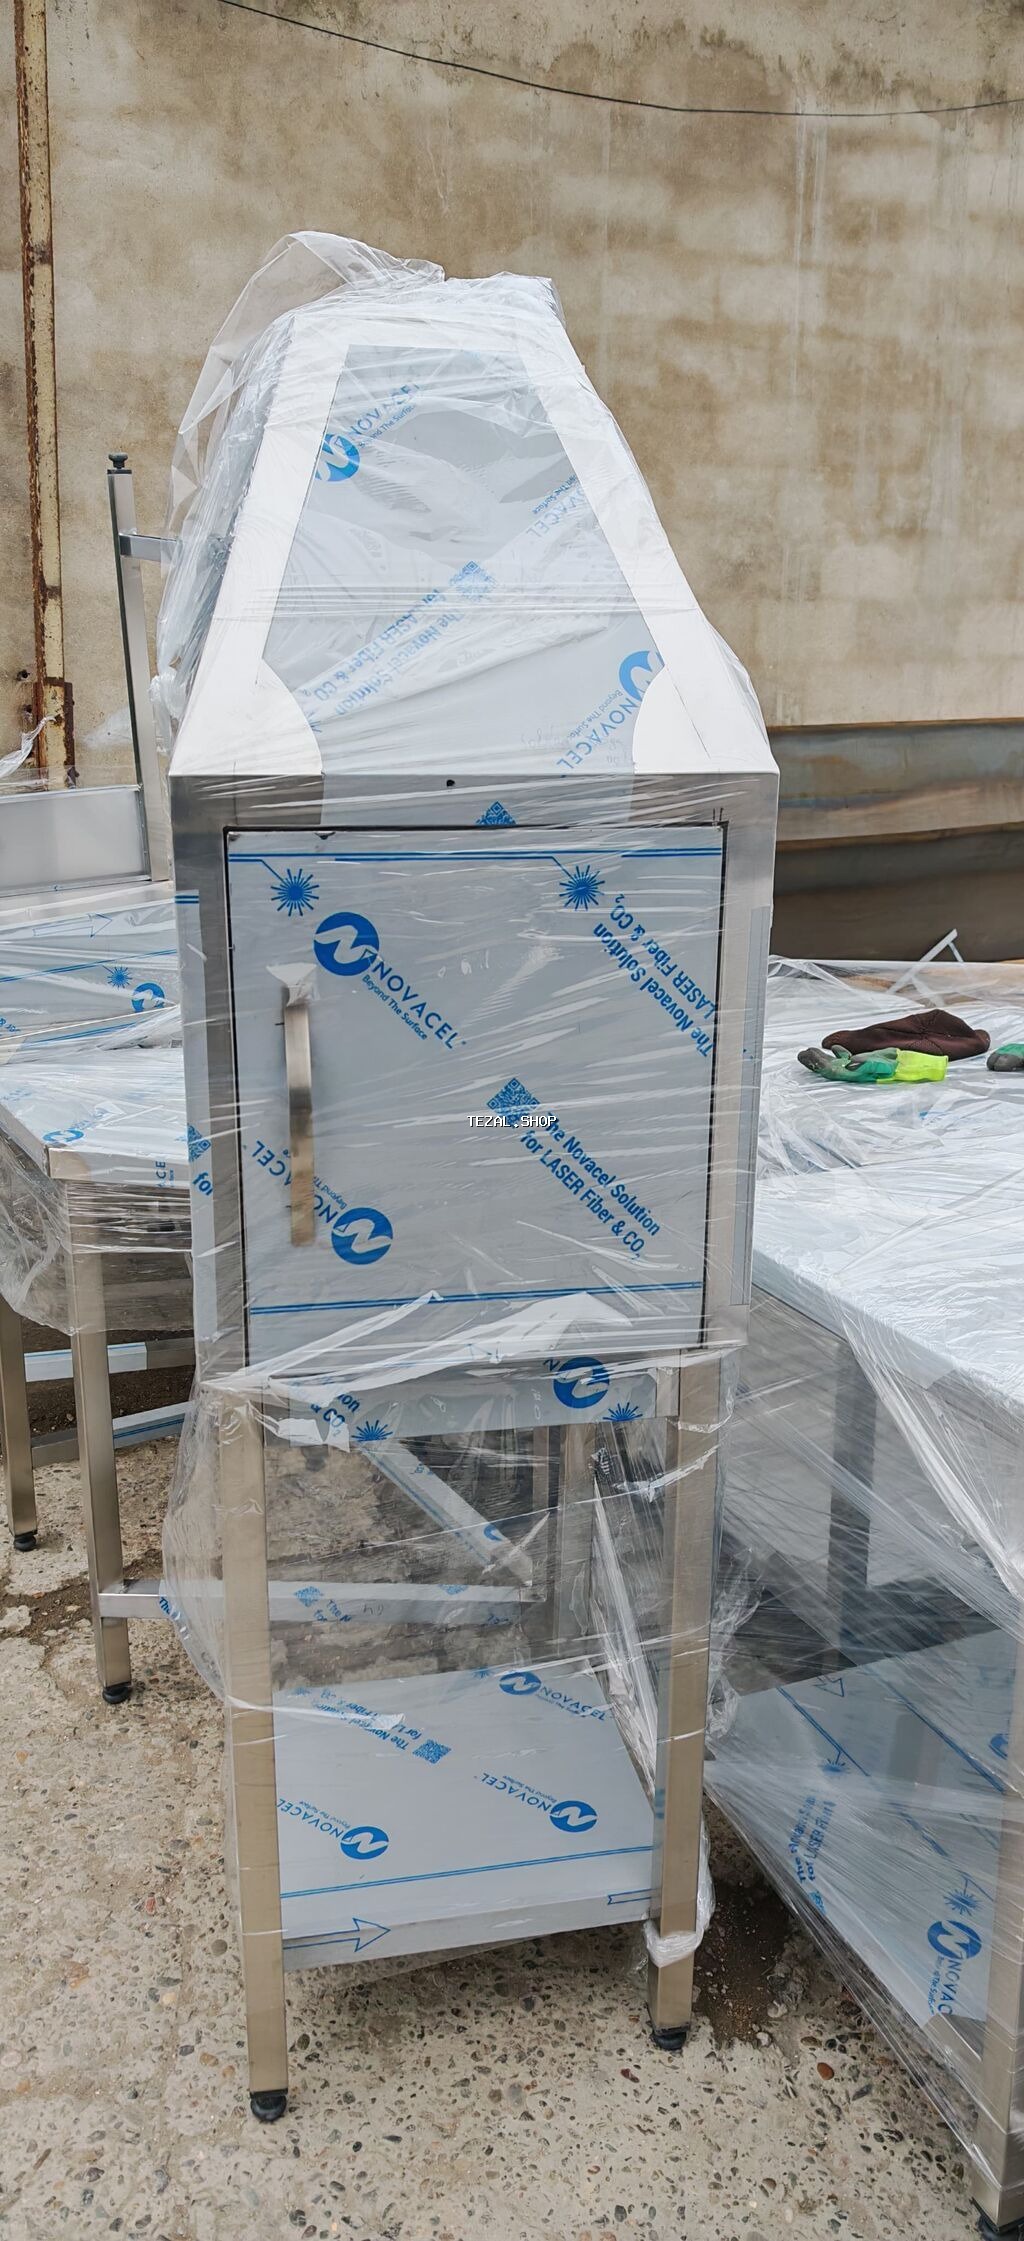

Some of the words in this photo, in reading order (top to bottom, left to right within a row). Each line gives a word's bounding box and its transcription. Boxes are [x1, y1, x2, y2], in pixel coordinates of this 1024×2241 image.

[333, 670, 350, 684] &
[349, 640, 385, 676] Fiber
[556, 697, 639, 769] NOVACEL
[587, 709, 603, 724] The
[593, 923, 646, 982] Solution
[630, 924, 646, 942] &
[641, 938, 678, 977] Fiber
[362, 974, 390, 1002] Beyond
[388, 998, 403, 1015] The
[401, 1012, 428, 1040] Surface
[372, 961, 458, 1049] NOVACEL
[639, 977, 694, 1033] Novacel
[672, 970, 717, 1020] LASER
[690, 1027, 715, 1058] The
[320, 1184, 348, 1210] Beyond
[520, 1130, 544, 1154] for
[539, 1149, 585, 1195] LASER
[579, 1188, 615, 1225] Fiber
[611, 1220, 626, 1237] &
[562, 1136, 617, 1188] Novacel
[610, 1183, 661, 1237] Solution
[540, 1686, 608, 1721] NOVACEL
[391, 1735, 410, 1750] The
[404, 1728, 423, 1741] for
[481, 1772, 552, 1811] NOVACEL
[277, 1798, 344, 1838] NOVACEL
